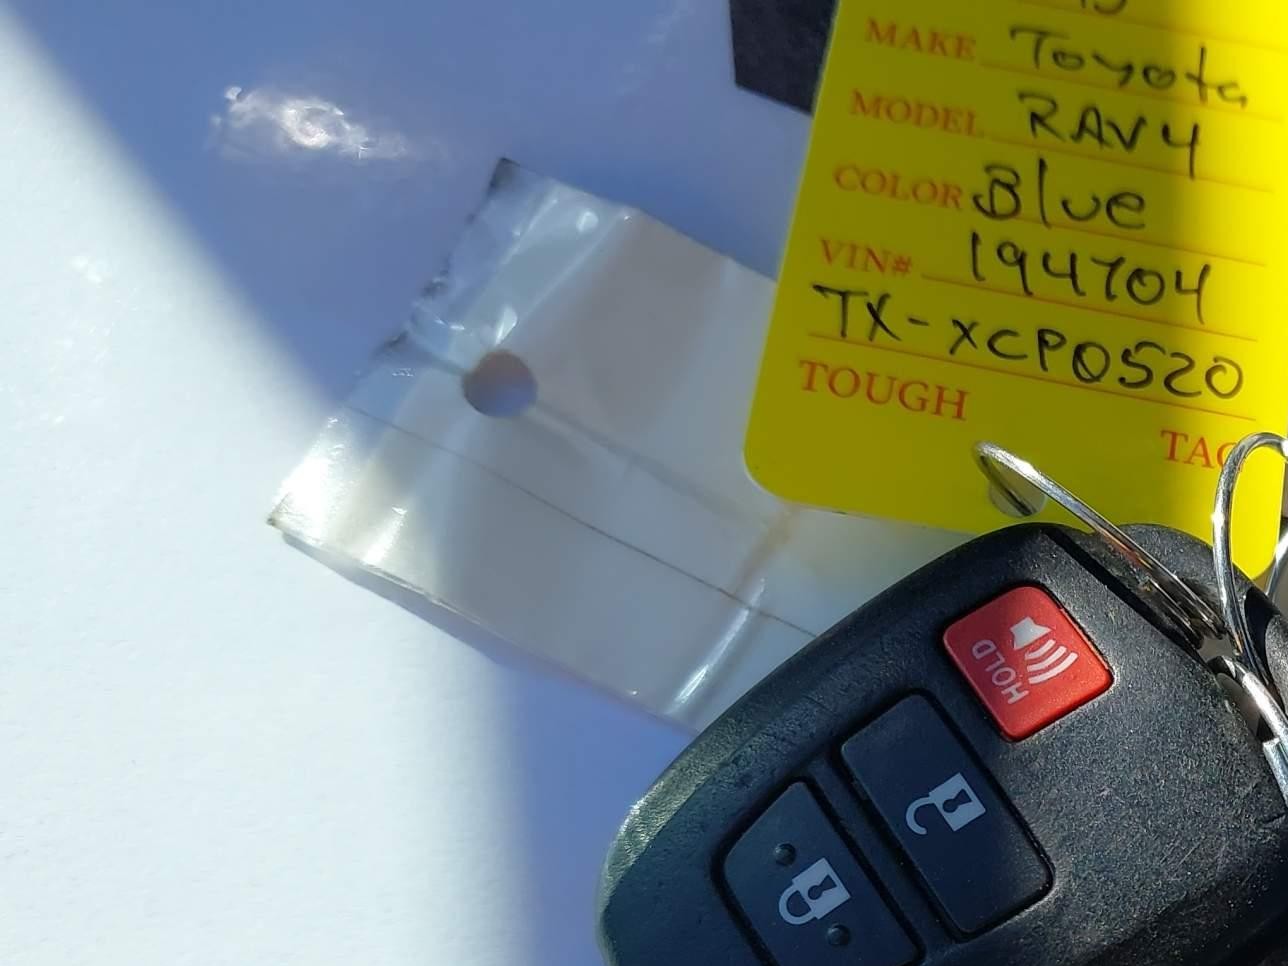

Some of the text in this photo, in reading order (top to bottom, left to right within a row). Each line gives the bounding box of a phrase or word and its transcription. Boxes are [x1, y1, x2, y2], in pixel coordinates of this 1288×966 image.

[865, 18, 977, 60] MAKE
[1009, 26, 1248, 109] Toyota
[850, 88, 985, 139] MODEL
[1018, 89, 1200, 180] RAV4
[833, 163, 963, 210] COLOR
[973, 158, 1146, 229] Blue
[820, 237, 912, 276] VIN#
[972, 231, 1211, 325] 194704
[798, 358, 971, 422] TOUGH
[971, 638, 1030, 705] HOLD
